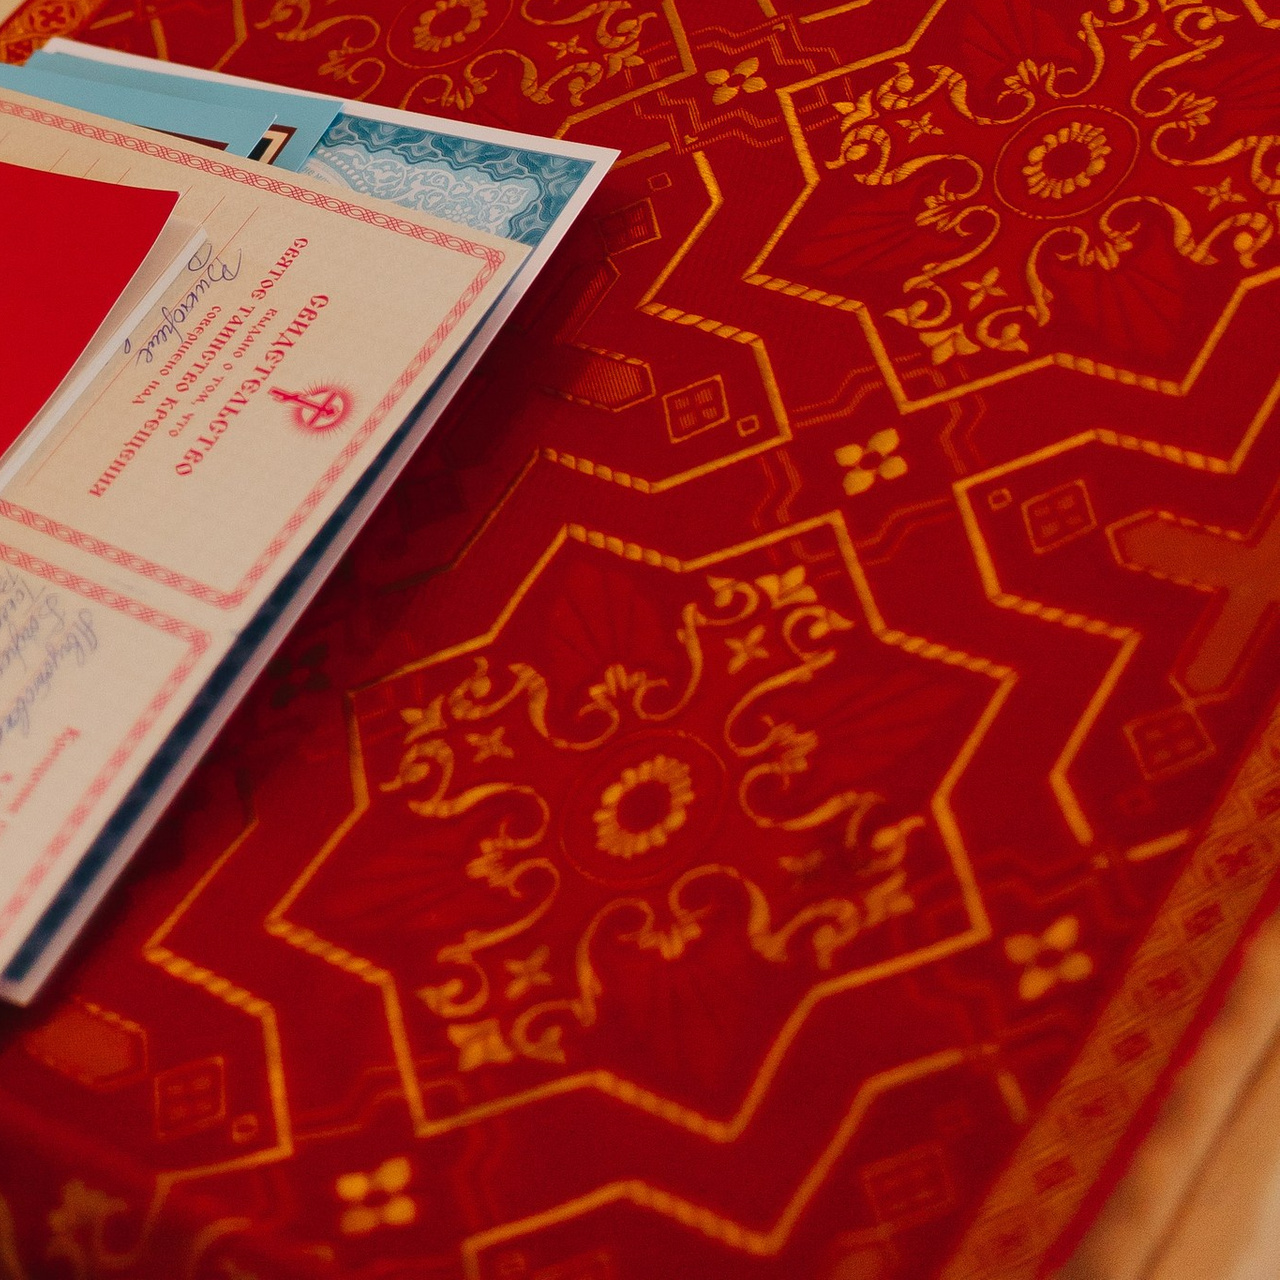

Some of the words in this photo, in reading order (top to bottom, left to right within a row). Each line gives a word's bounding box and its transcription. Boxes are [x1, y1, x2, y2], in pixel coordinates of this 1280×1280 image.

[251, 237, 309, 300] СВЯТОЕ
[160, 305, 222, 377] совершено
[175, 306, 253, 393] ТАИНСТВО
[233, 308, 278, 359] выдано
[131, 379, 161, 406] над
[175, 293, 330, 477] СВИДЕТЕЛЬСТВО
[88, 396, 178, 498] КРЕЩЕНИЯ
